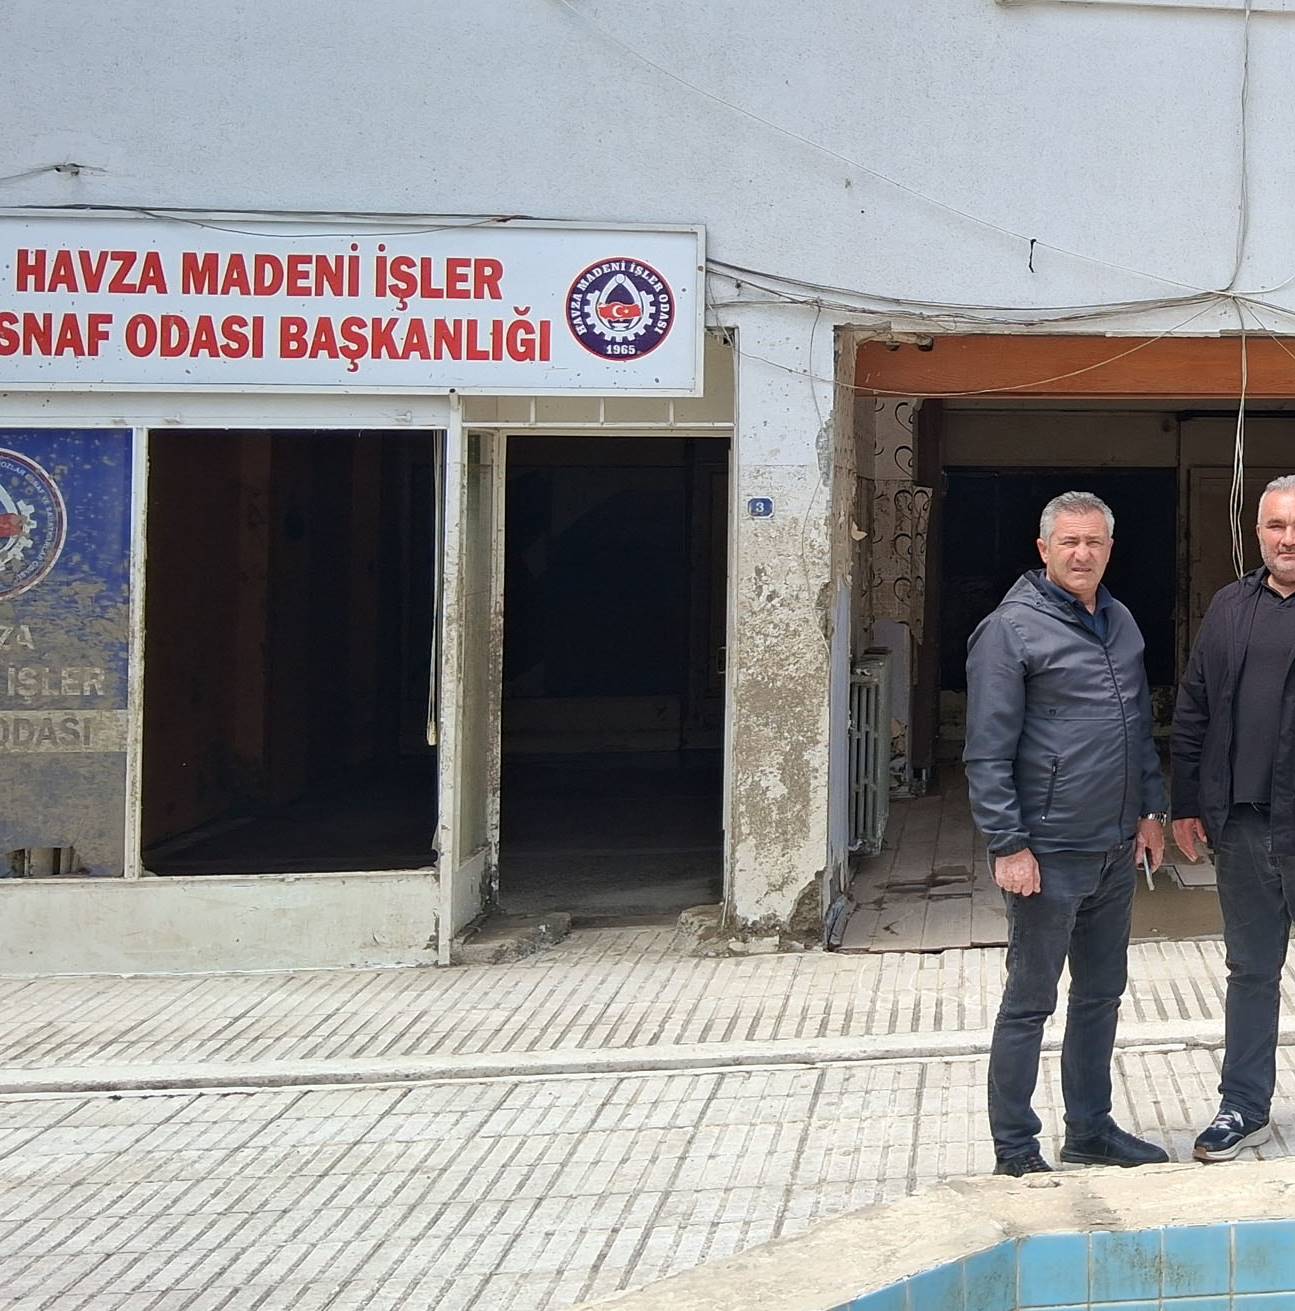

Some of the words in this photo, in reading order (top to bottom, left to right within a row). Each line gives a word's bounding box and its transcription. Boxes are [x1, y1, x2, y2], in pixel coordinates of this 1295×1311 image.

[17, 248, 169, 295] HAVZA
[181, 243, 361, 297] MADENİ
[375, 243, 503, 311] İŞLER
[576, 260, 627, 291] MADENİ
[628, 261, 664, 292] İŞLER
[570, 293, 587, 336] HAVZA
[654, 294, 670, 335] ODASI
[0, 311, 113, 357] SNAF
[125, 313, 264, 359] ODASI
[279, 306, 551, 373] BAŞKANLIĞI
[606, 344, 636, 355] 1965
[755, 501, 765, 513] 3
[7, 662, 105, 704] İŞLER
